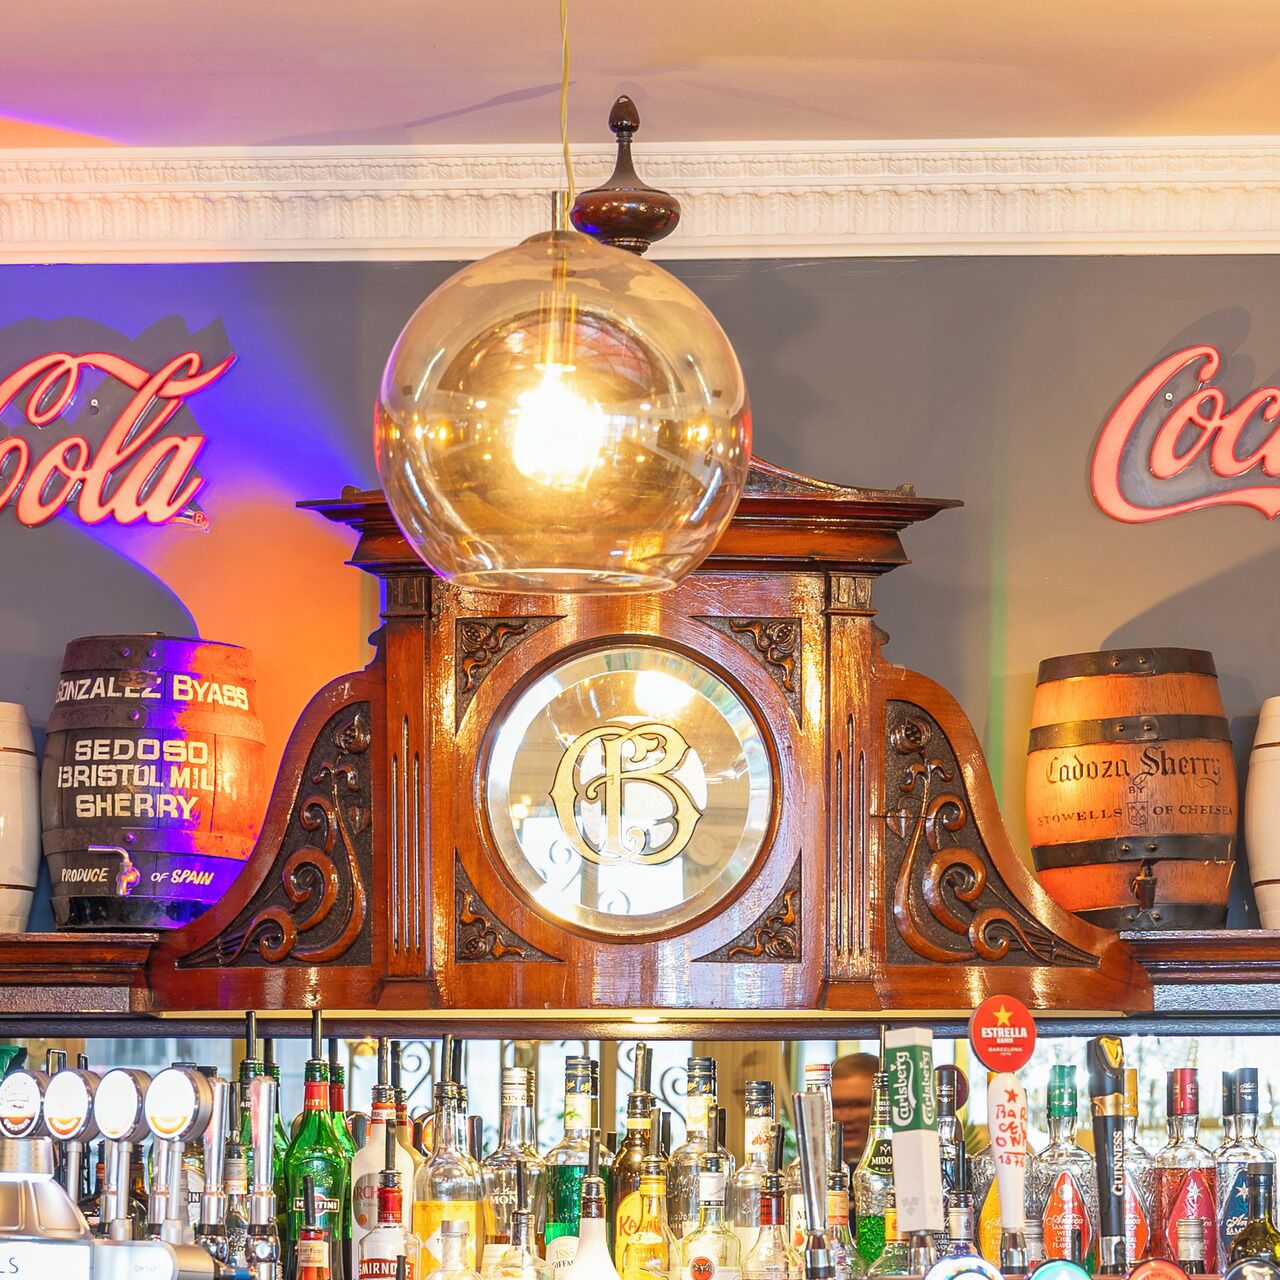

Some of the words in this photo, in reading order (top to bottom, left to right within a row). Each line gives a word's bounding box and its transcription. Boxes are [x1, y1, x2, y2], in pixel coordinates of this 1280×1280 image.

[173, 674, 249, 711] BYASS
[75, 739, 208, 764] SEDOSO
[58, 765, 164, 789] BRISTOL
[1139, 744, 1222, 793] Sherry
[76, 793, 198, 819] SHERRY
[1037, 807, 1123, 827] STOWELLS
[1153, 805, 1174, 816] OF
[1178, 803, 1234, 816] CHELSEA
[61, 867, 108, 883] PRODUCE
[151, 872, 169, 882] OF
[171, 870, 214, 886] SPAIN
[981, 1027, 1027, 1038] ESTRELLA
[890, 1051, 918, 1127] Carlsberg
[920, 1051, 937, 1126] Carlsberg
[871, 1156, 893, 1165] MIDO
[1113, 1131, 1123, 1196] GUINNESS
[295, 1200, 338, 1210] MRTINI
